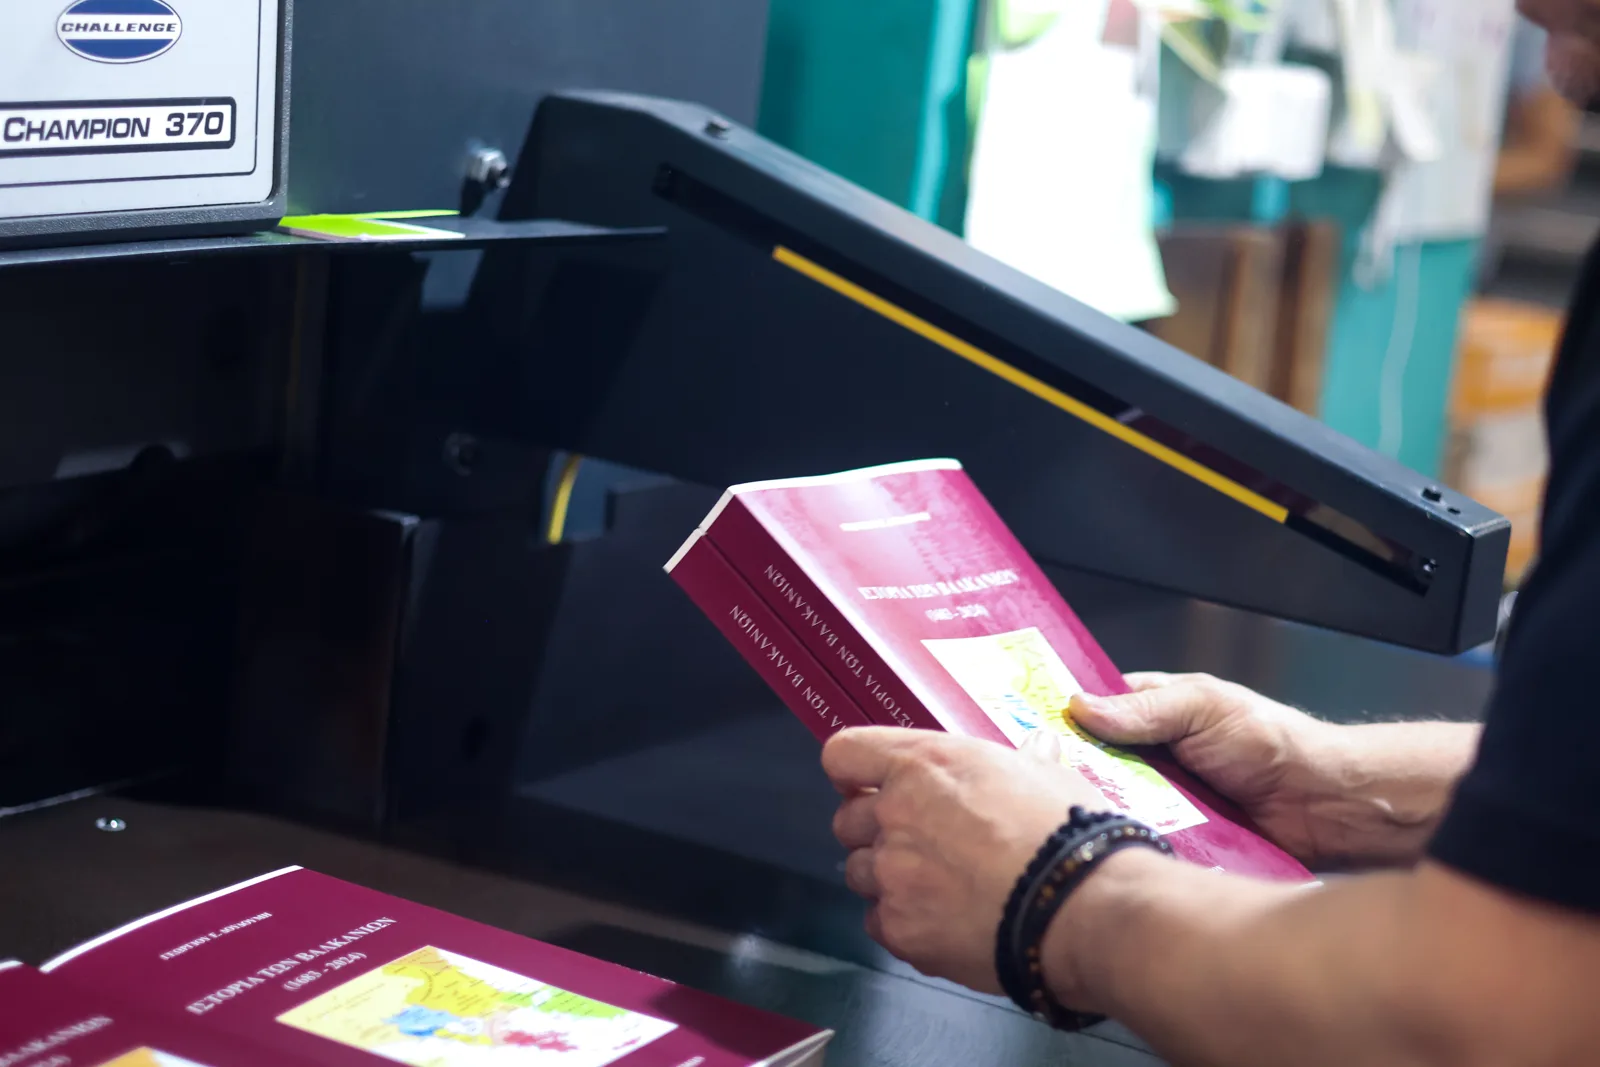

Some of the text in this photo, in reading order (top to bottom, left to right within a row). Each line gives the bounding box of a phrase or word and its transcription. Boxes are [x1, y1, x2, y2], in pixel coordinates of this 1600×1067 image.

[61, 22, 177, 33] CHALLENGE
[3, 111, 225, 142] CHAMPION 370
[764, 564, 840, 648] ΒΑΛΚΑΝΙΩΝ
[729, 604, 831, 719] ΤΩΝ ΒΑΛΚΑΝΙΩΝ
[836, 645, 865, 678] ΤΩΝ
[186, 975, 266, 1015] ΙΣΤΟΡΙΑ
[257, 957, 301, 979] ΤΩΝ
[295, 916, 397, 962] ΒΑΛΚΑΝΙΩΝ
